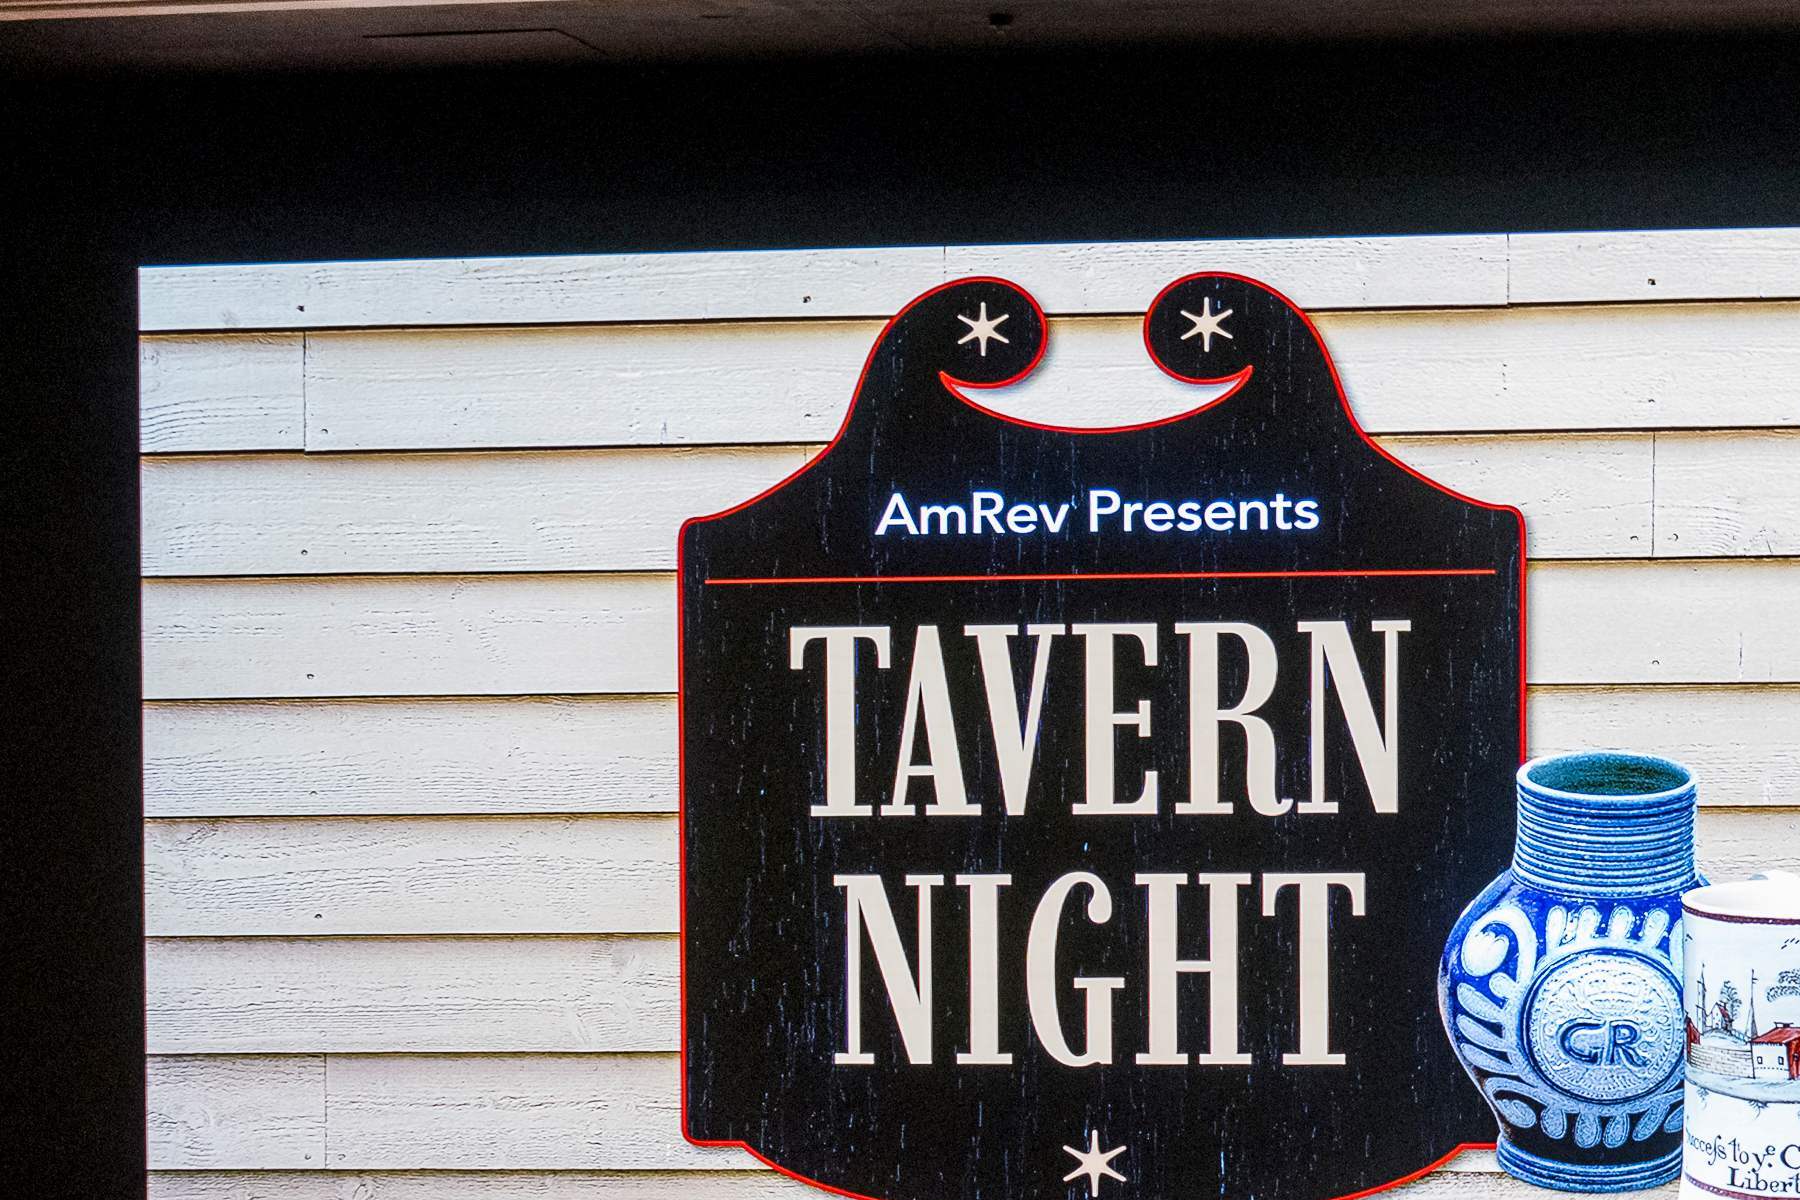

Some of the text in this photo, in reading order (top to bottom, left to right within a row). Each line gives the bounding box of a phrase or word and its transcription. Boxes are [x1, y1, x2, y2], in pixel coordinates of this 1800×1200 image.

[875, 490, 1319, 535] AmRev Presents
[790, 620, 1411, 816] TAVERN
[834, 872, 1365, 1066] NIGHT
